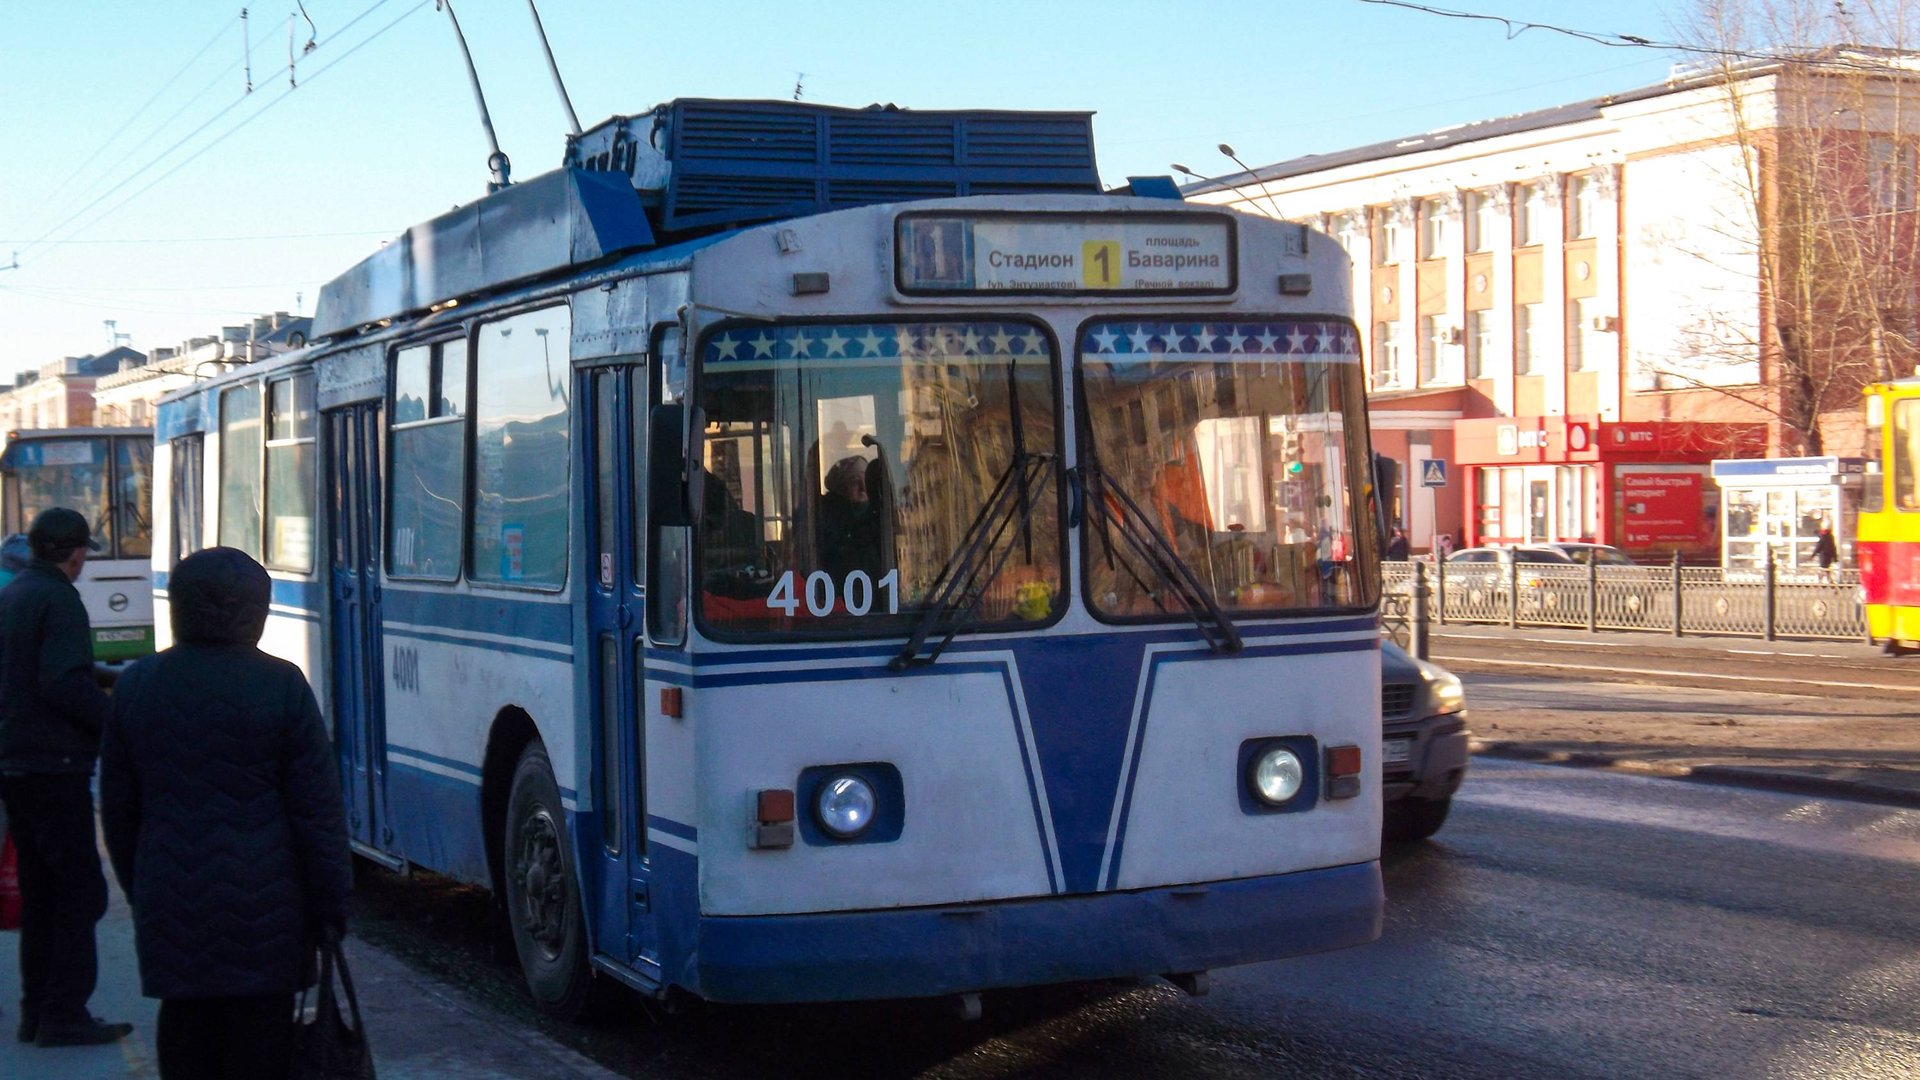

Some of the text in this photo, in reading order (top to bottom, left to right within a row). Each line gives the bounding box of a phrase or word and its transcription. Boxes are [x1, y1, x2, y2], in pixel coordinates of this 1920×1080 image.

[930, 223, 946, 279] 1
[1145, 237, 1200, 248] площадь
[988, 250, 1074, 270] Стадион
[1094, 245, 1110, 283] 1
[1127, 250, 1220, 271] Баварина
[1518, 430, 1548, 448] МТС
[1629, 431, 1653, 441] МТС
[766, 568, 899, 617] 4001
[392, 644, 420, 695] 4001
